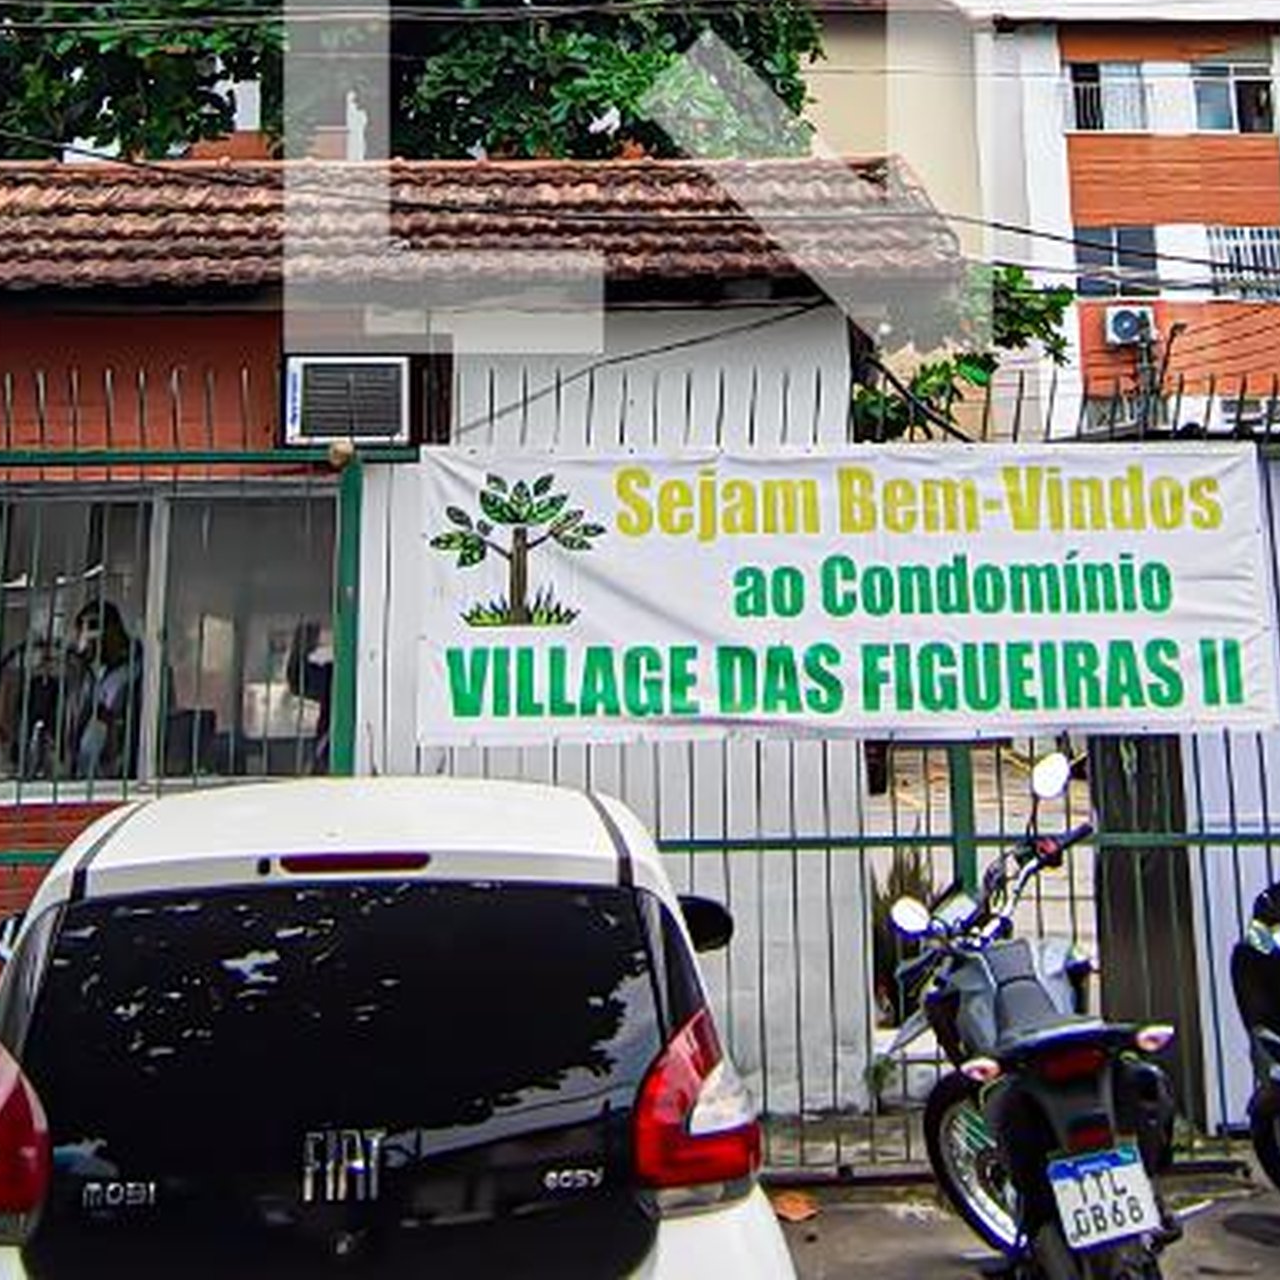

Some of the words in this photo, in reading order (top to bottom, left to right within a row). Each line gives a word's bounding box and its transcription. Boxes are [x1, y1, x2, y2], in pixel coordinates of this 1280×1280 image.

[615, 467, 821, 542] Sejam
[836, 464, 1221, 535] Bem-Vindos
[732, 564, 804, 618] ao
[821, 549, 1174, 616] Condomínio
[446, 645, 700, 718] VILLAGE
[719, 641, 844, 715] DAS
[861, 638, 1186, 712] FIGUEIRAS
[1198, 637, 1244, 706] II
[82, 1182, 156, 1208] MOBI
[303, 1128, 387, 1201] FIAT
